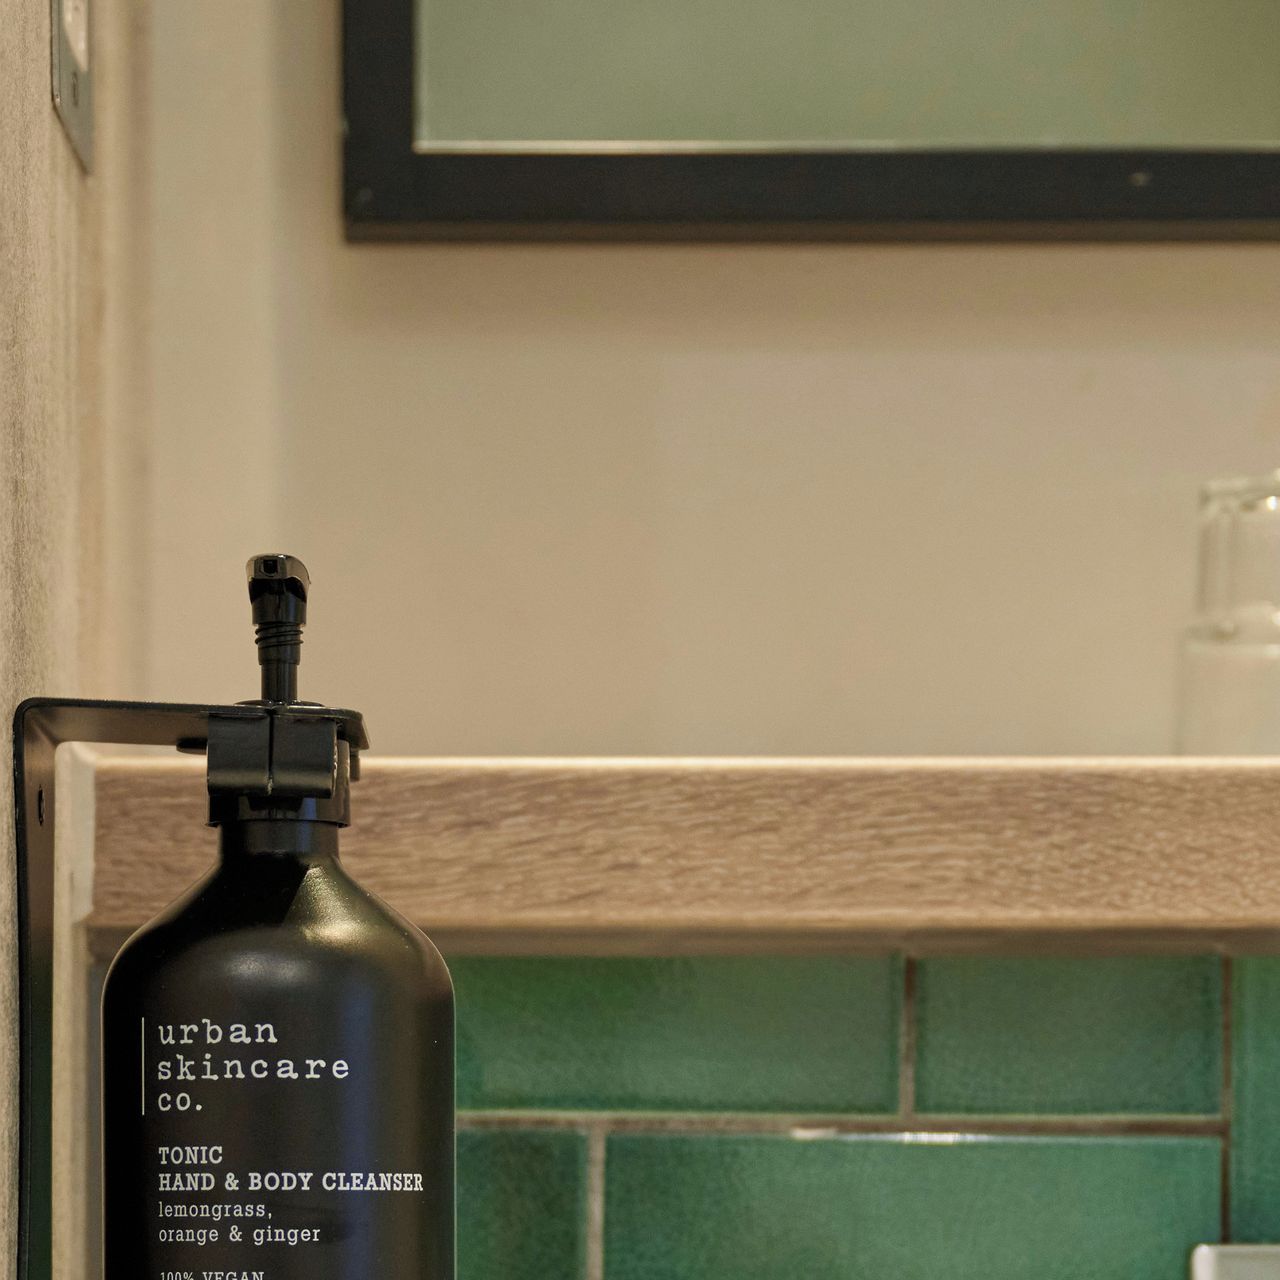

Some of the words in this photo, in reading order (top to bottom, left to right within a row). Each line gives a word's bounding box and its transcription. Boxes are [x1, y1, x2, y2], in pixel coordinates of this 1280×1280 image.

[158, 1018, 278, 1045] urban
[158, 1052, 350, 1081] skincare
[158, 1092, 203, 1112] co.
[158, 1145, 223, 1165] TONIC
[158, 1172, 216, 1191] HAND
[224, 1172, 240, 1191] &
[248, 1172, 314, 1191] BODY
[321, 1172, 424, 1192] CLEANSER
[158, 1201, 273, 1222] lemongrass,
[158, 1228, 220, 1246] orange
[229, 1224, 243, 1242] &
[253, 1225, 321, 1246] ginger
